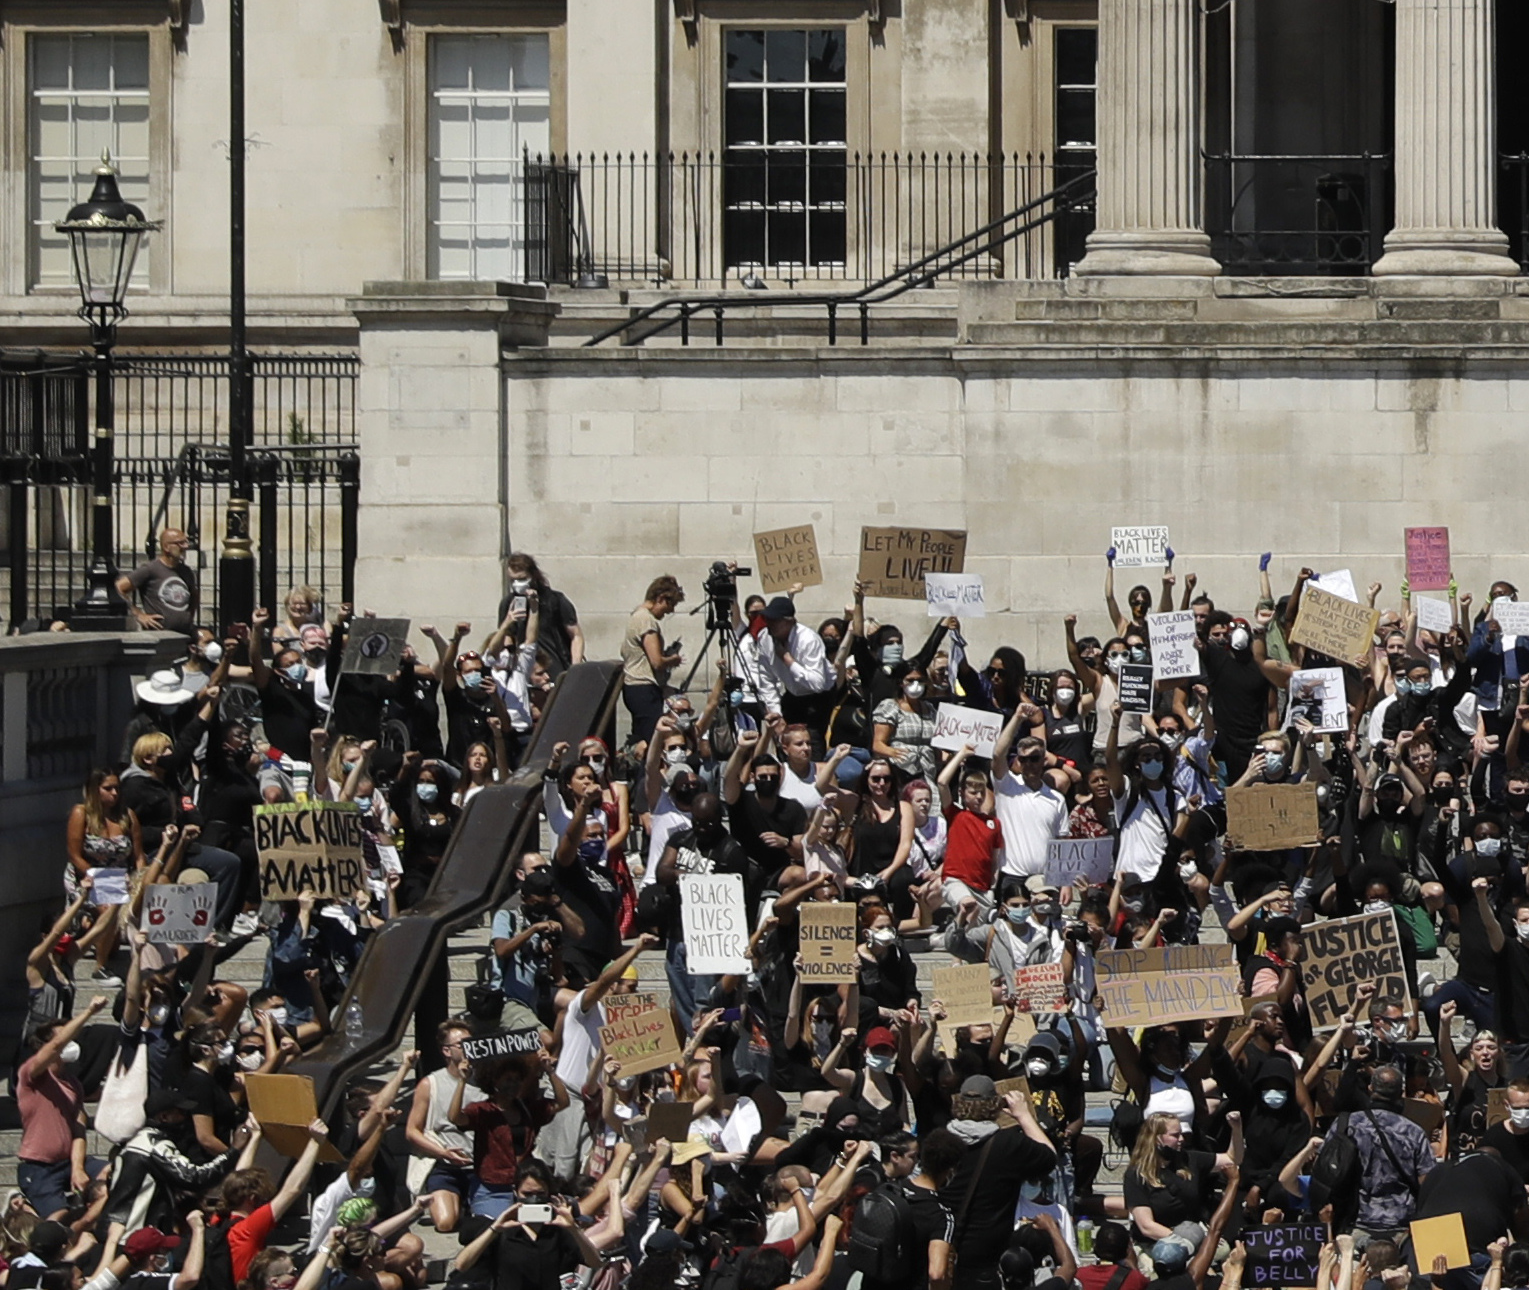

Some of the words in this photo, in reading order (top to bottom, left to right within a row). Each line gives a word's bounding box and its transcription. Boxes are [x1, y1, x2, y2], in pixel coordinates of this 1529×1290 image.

[760, 531, 811, 554] BLACK
[863, 532, 895, 552] LET
[898, 531, 916, 549] MY
[919, 531, 956, 555] PEOPLE
[1114, 528, 1140, 539] BLACK
[1142, 527, 1168, 539] LIVES
[1113, 537, 1168, 555] MATTER
[764, 547, 816, 567] LIVES
[761, 565, 817, 586] MATTER
[1309, 589, 1344, 612] BLACK
[1345, 604, 1372, 624] LIVES
[1150, 612, 1194, 626] VIOLATION
[1165, 625, 1176, 634] OF
[1318, 608, 1361, 631] MATTER
[1160, 664, 1193, 676] POWER
[1323, 711, 1345, 728] ENT
[690, 883, 735, 905] BLACK
[690, 911, 734, 932] LIVES
[153, 929, 201, 942] MURDER
[801, 926, 855, 942] SILENCE
[1297, 916, 1396, 958] JUSTICE
[690, 933, 742, 959] MATTER
[801, 962, 855, 977] VIOLENCE
[1097, 951, 1146, 982] STOP
[1162, 945, 1230, 977] KILLING
[1301, 963, 1323, 989] FOR
[1326, 948, 1403, 986] GEORGE
[604, 996, 631, 1008] RAISE
[635, 992, 656, 1005] THE
[1103, 983, 1139, 1019] THE
[1143, 973, 1240, 1014] MANDEM
[463, 1040, 495, 1060] REST
[493, 1038, 508, 1054] IN
[508, 1032, 542, 1053] POWER
[1246, 1226, 1324, 1248] JUSTICE
[1268, 1246, 1307, 1261] FOR
[1254, 1263, 1319, 1282] BELLY
